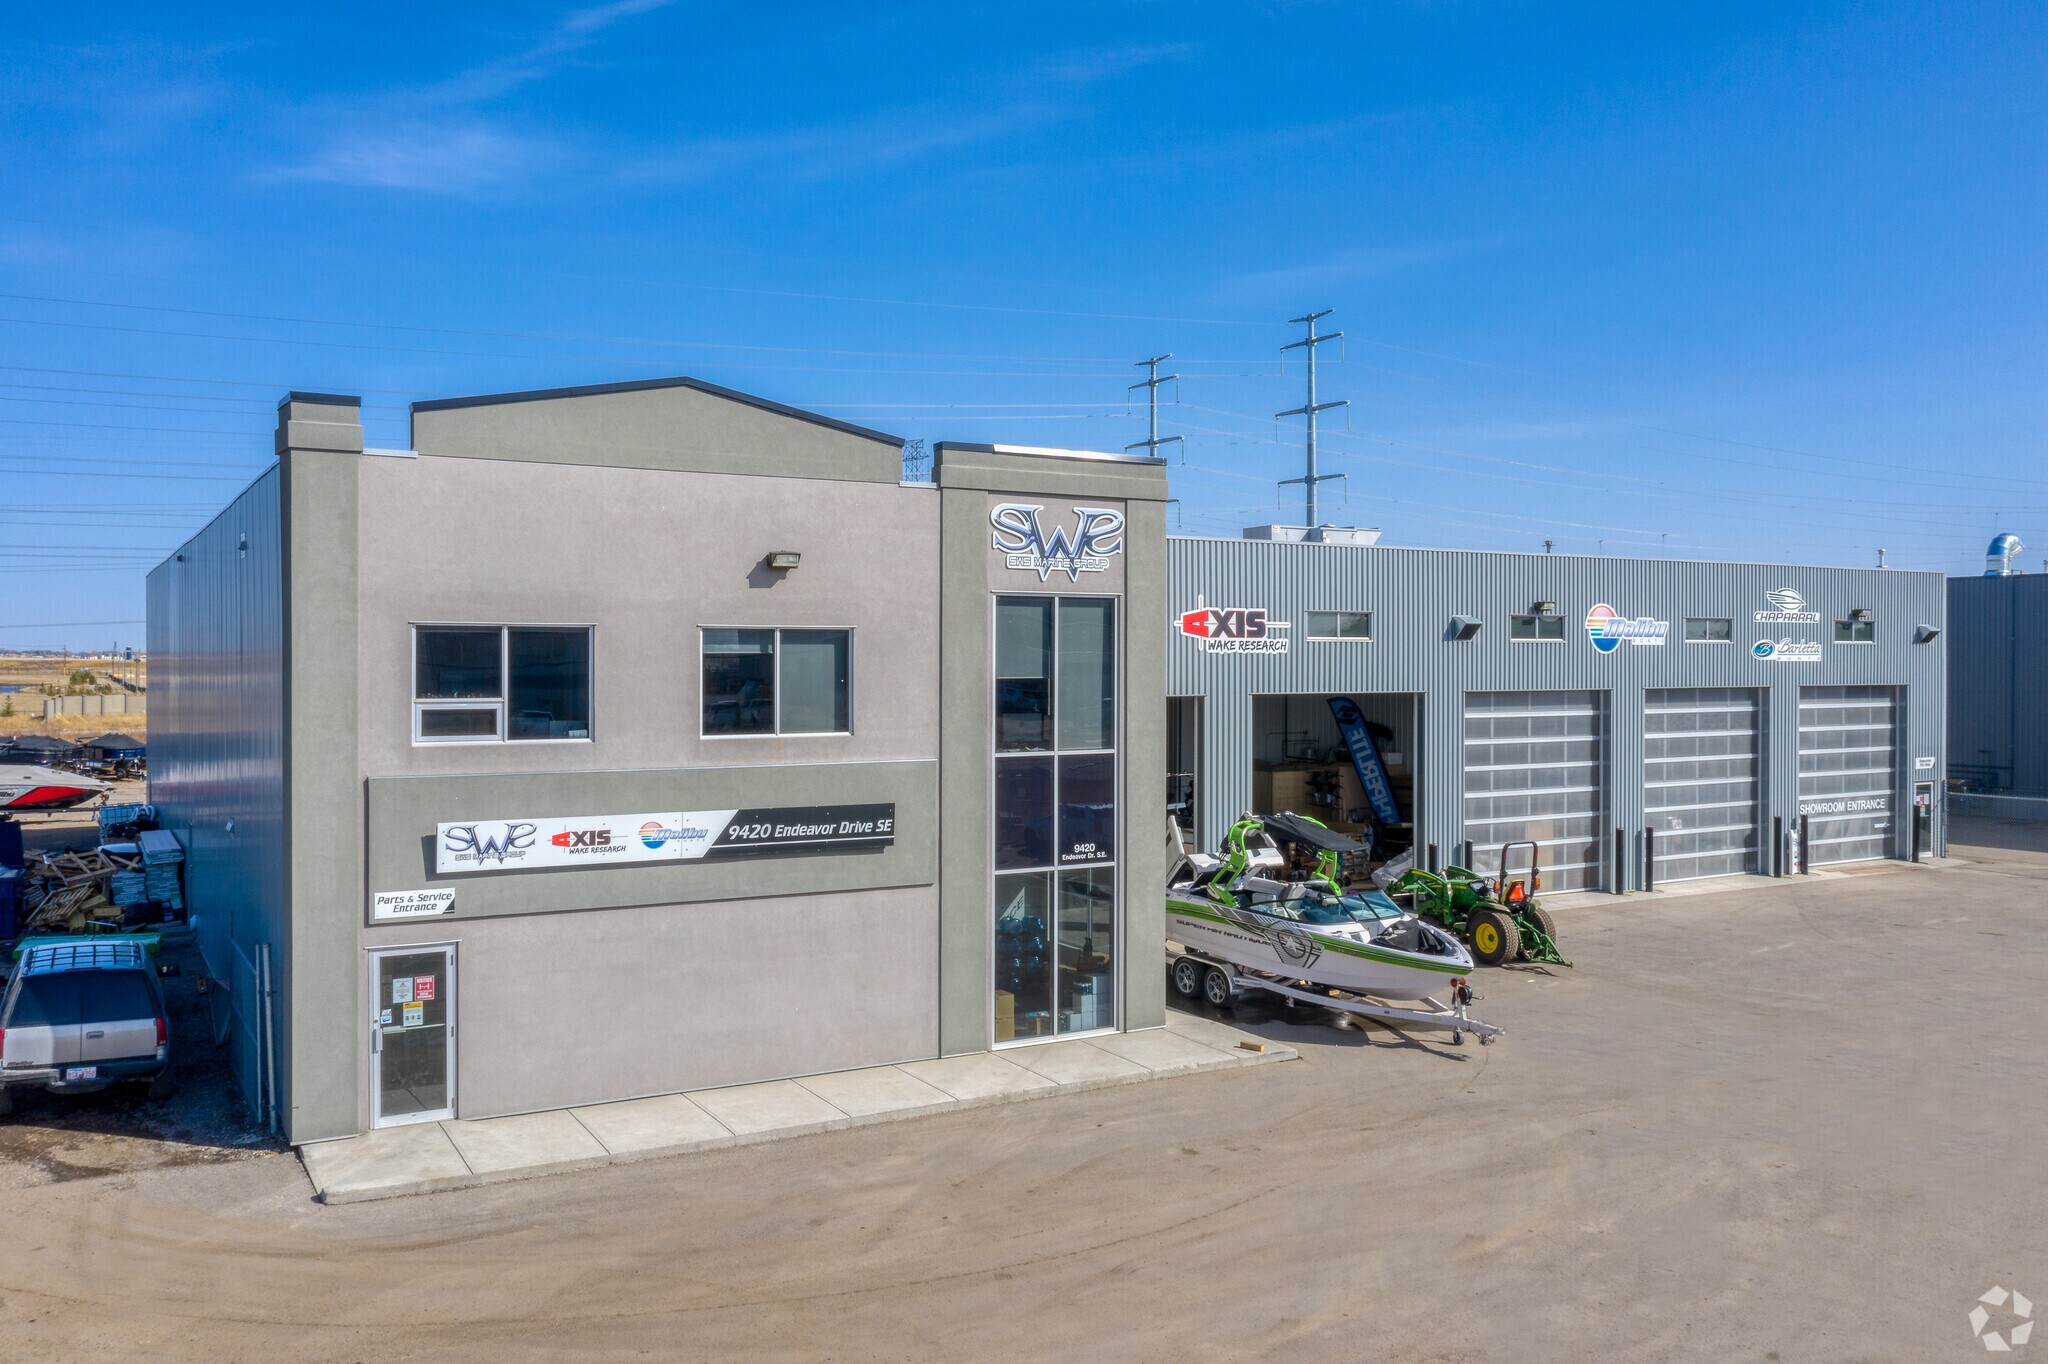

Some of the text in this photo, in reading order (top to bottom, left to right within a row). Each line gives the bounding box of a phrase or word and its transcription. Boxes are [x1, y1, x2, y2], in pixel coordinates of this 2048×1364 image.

[1034, 557, 1071, 568] MARINE
[1073, 558, 1109, 569] GROUP
[1753, 612, 1819, 622] CHAPARRAL
[1182, 609, 1266, 638] AXIS
[1603, 619, 1667, 637] Malibu
[1208, 640, 1287, 652] WAKE RESEARCH
[1777, 639, 1820, 653] Barletta
[1800, 798, 1886, 815] SHOWROOM ENTRANCE
[652, 827, 709, 840] Malibu
[728, 819, 893, 839] 9420 Endeavor Drive SE
[552, 829, 611, 847] AXIS
[569, 845, 627, 855] WAKE RESEARCH
[1074, 843, 1095, 853] 9420
[377, 896, 405, 905] Parts
[417, 893, 453, 902] Service
[393, 903, 437, 913] Entrance
[1176, 919, 1206, 931] SUPER
